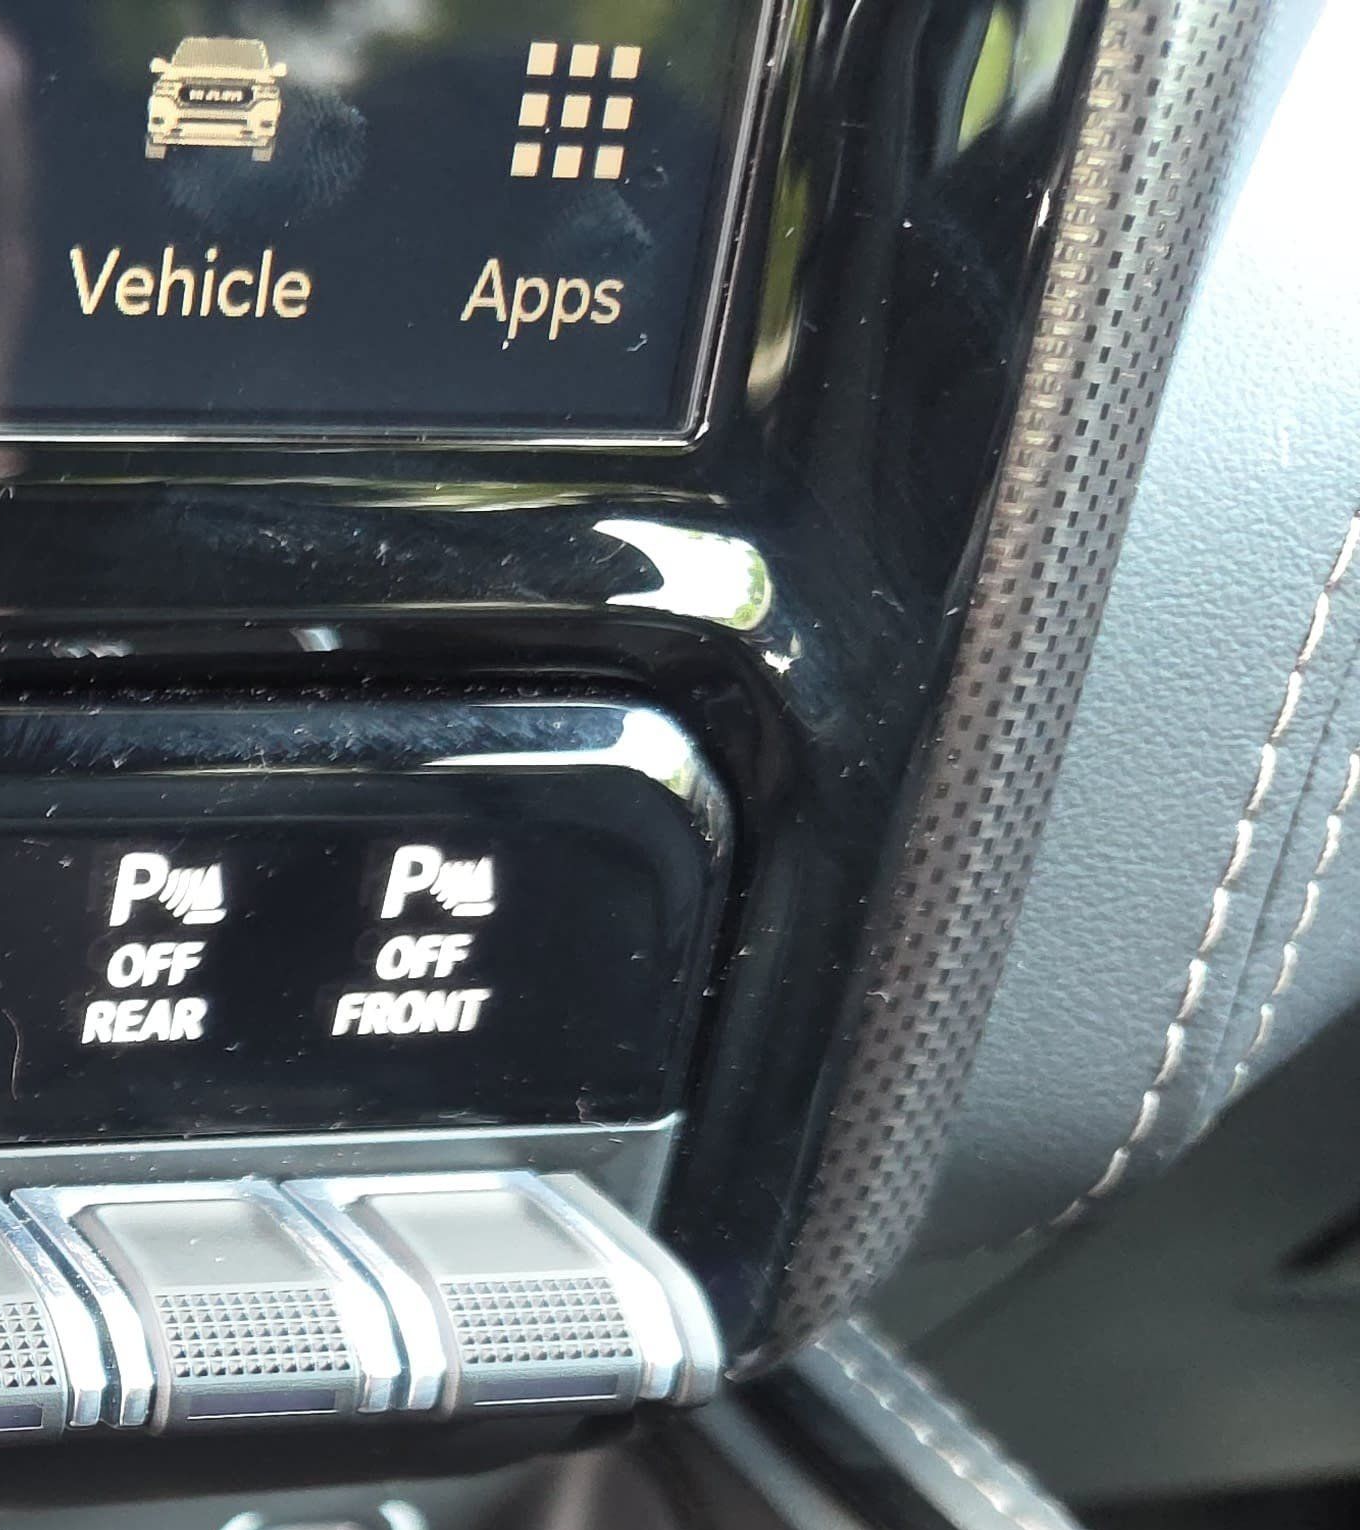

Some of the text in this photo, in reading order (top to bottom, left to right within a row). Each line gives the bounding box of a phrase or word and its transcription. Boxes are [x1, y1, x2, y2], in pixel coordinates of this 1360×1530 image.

[70, 247, 310, 317] Vehicle
[461, 259, 623, 340] Apps
[107, 942, 205, 988] OFF
[376, 934, 472, 980] OFF
[82, 998, 207, 1043] REAR
[332, 989, 490, 1035] FRONT
